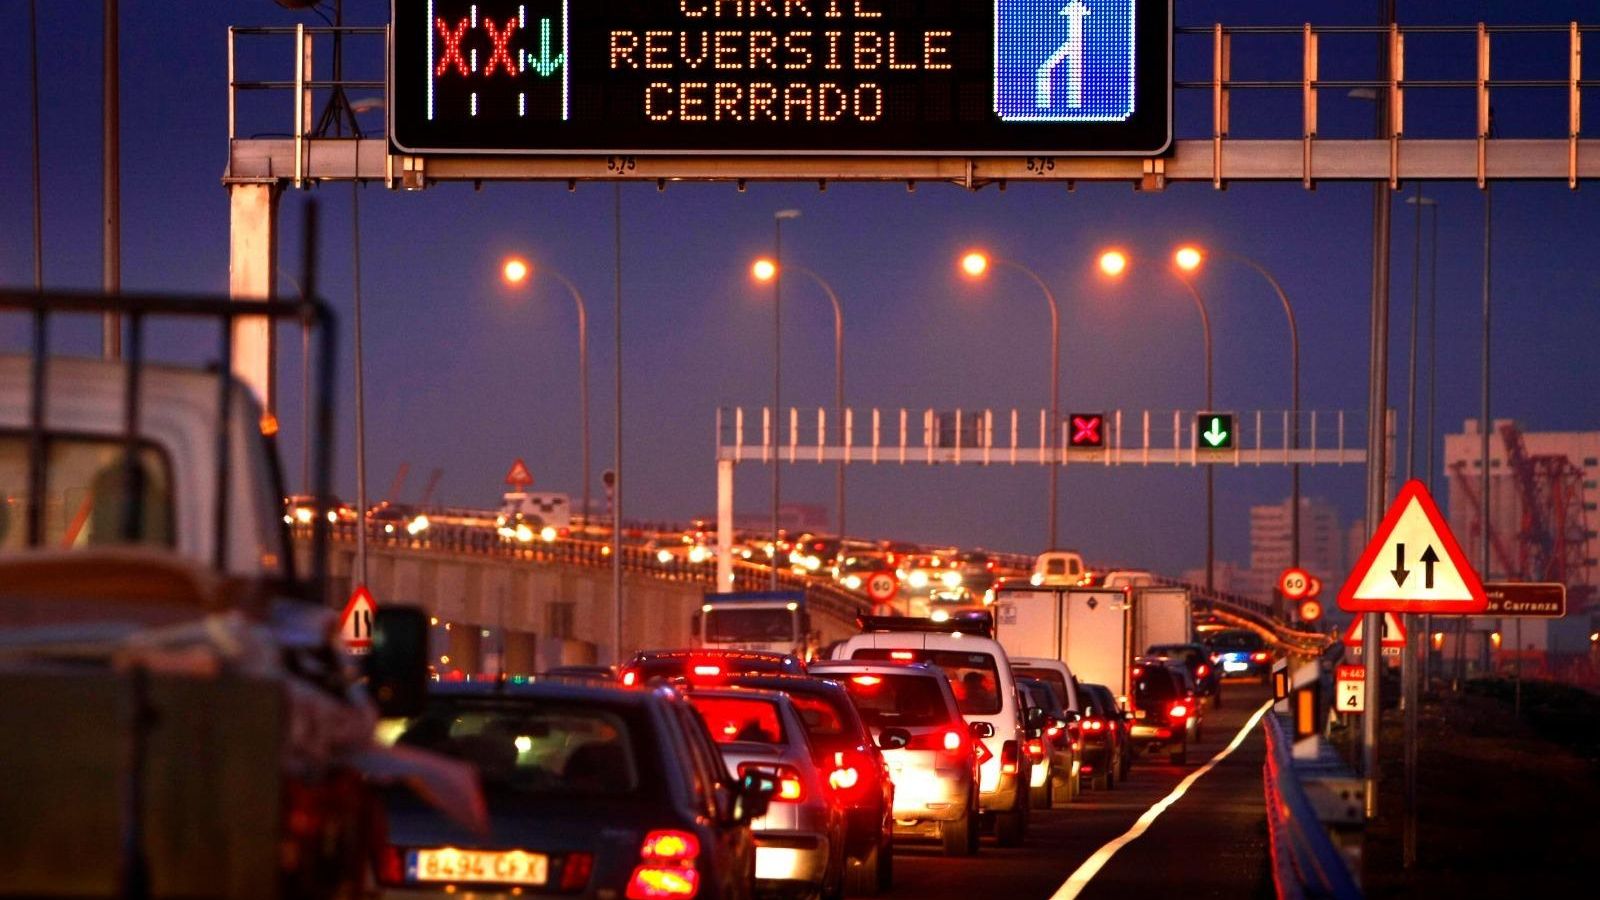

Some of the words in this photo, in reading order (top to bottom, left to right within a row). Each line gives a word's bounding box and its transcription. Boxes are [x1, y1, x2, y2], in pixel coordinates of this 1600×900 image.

[611, 31, 951, 69] REVERSIBLE
[646, 83, 881, 121] CERRADO
[607, 156, 636, 171] 5,75
[1026, 156, 1055, 172] 5,75
[873, 580, 889, 592] 60
[1286, 578, 1303, 589] 60
[1504, 600, 1558, 610] Carranza
[1346, 694, 1358, 707] 4
